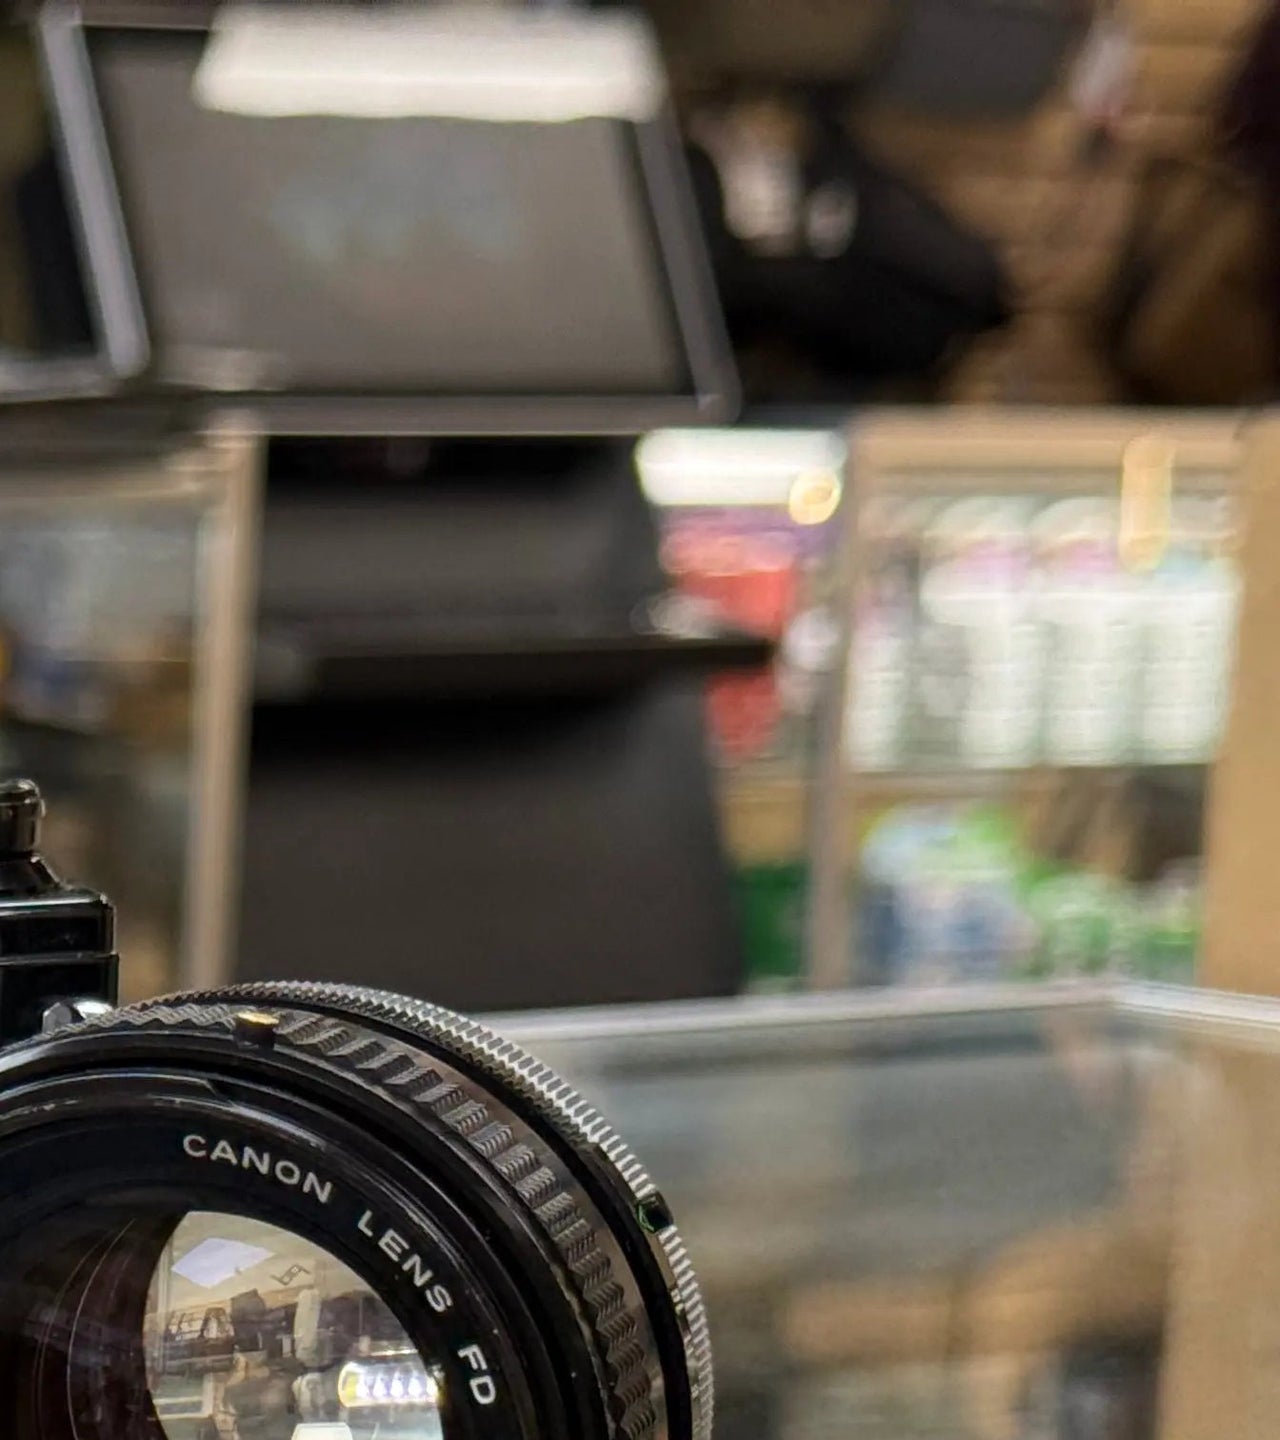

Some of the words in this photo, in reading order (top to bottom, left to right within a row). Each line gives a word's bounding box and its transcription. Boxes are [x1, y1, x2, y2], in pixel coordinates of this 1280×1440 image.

[183, 1134, 333, 1204] CANON
[357, 1209, 454, 1313] LENS
[458, 1344, 497, 1405] FD
